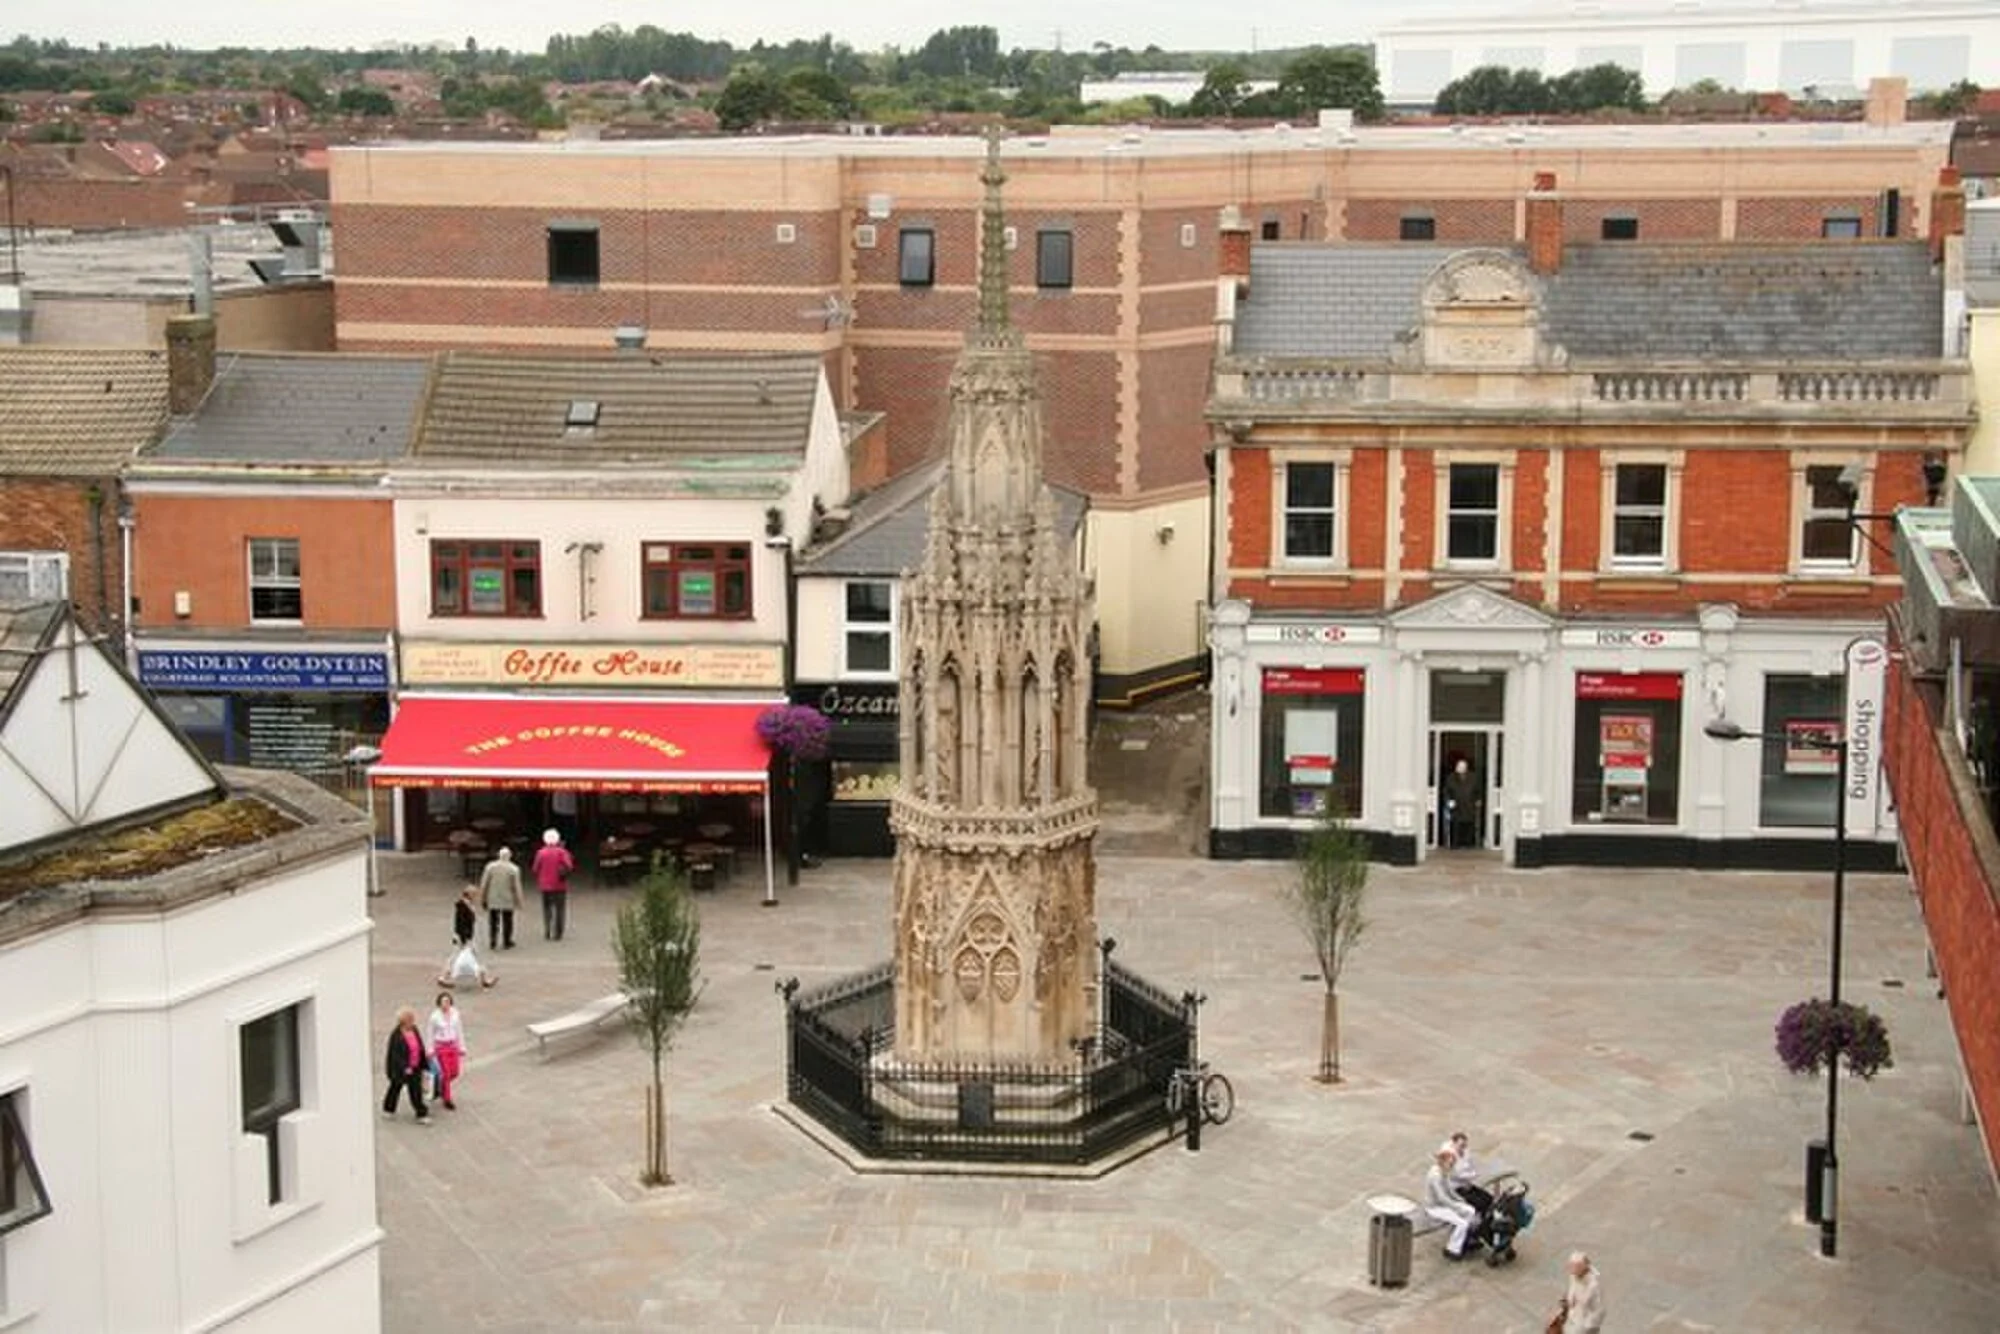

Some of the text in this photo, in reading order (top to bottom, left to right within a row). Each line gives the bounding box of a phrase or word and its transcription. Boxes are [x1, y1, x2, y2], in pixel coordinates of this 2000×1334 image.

[1280, 626, 1315, 639] HSBC
[1598, 630, 1632, 644] HSBC
[142, 655, 383, 671] BRINDLEY GOLDSTEIN
[504, 648, 683, 682] Coffee House
[464, 725, 686, 758] THE COFFEE HOUSE
[1850, 699, 1876, 799] Shopping
